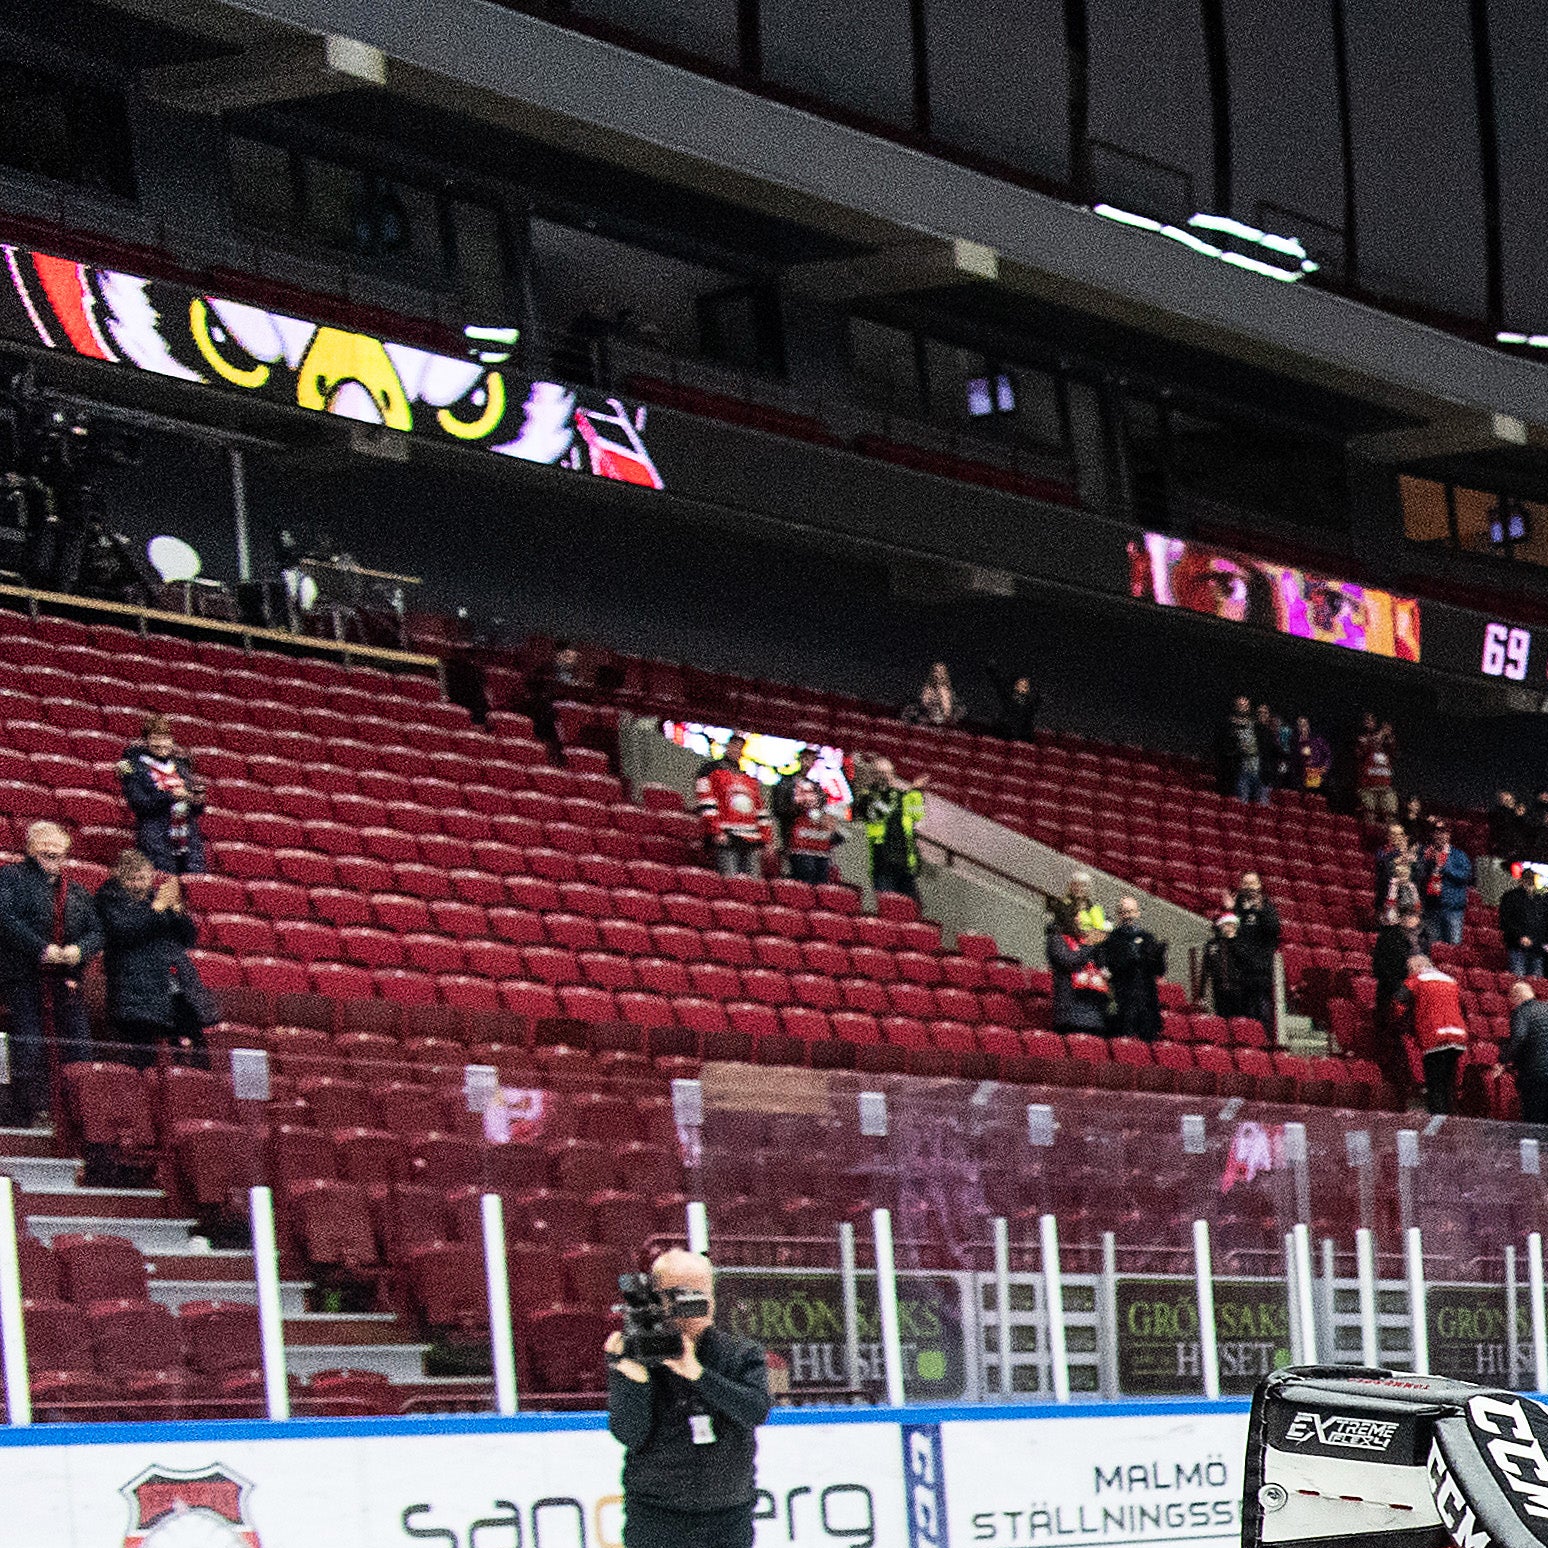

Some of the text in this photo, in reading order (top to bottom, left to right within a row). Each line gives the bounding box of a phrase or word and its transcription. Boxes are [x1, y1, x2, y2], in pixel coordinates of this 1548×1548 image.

[1482, 623, 1530, 681] 69
[1176, 1341, 1275, 1376] HSET
[1285, 1411, 1400, 1444] EXTREME
[1094, 1453, 1229, 1495] MALMÖ
[972, 1500, 1242, 1541] STÄLLNINGSS
